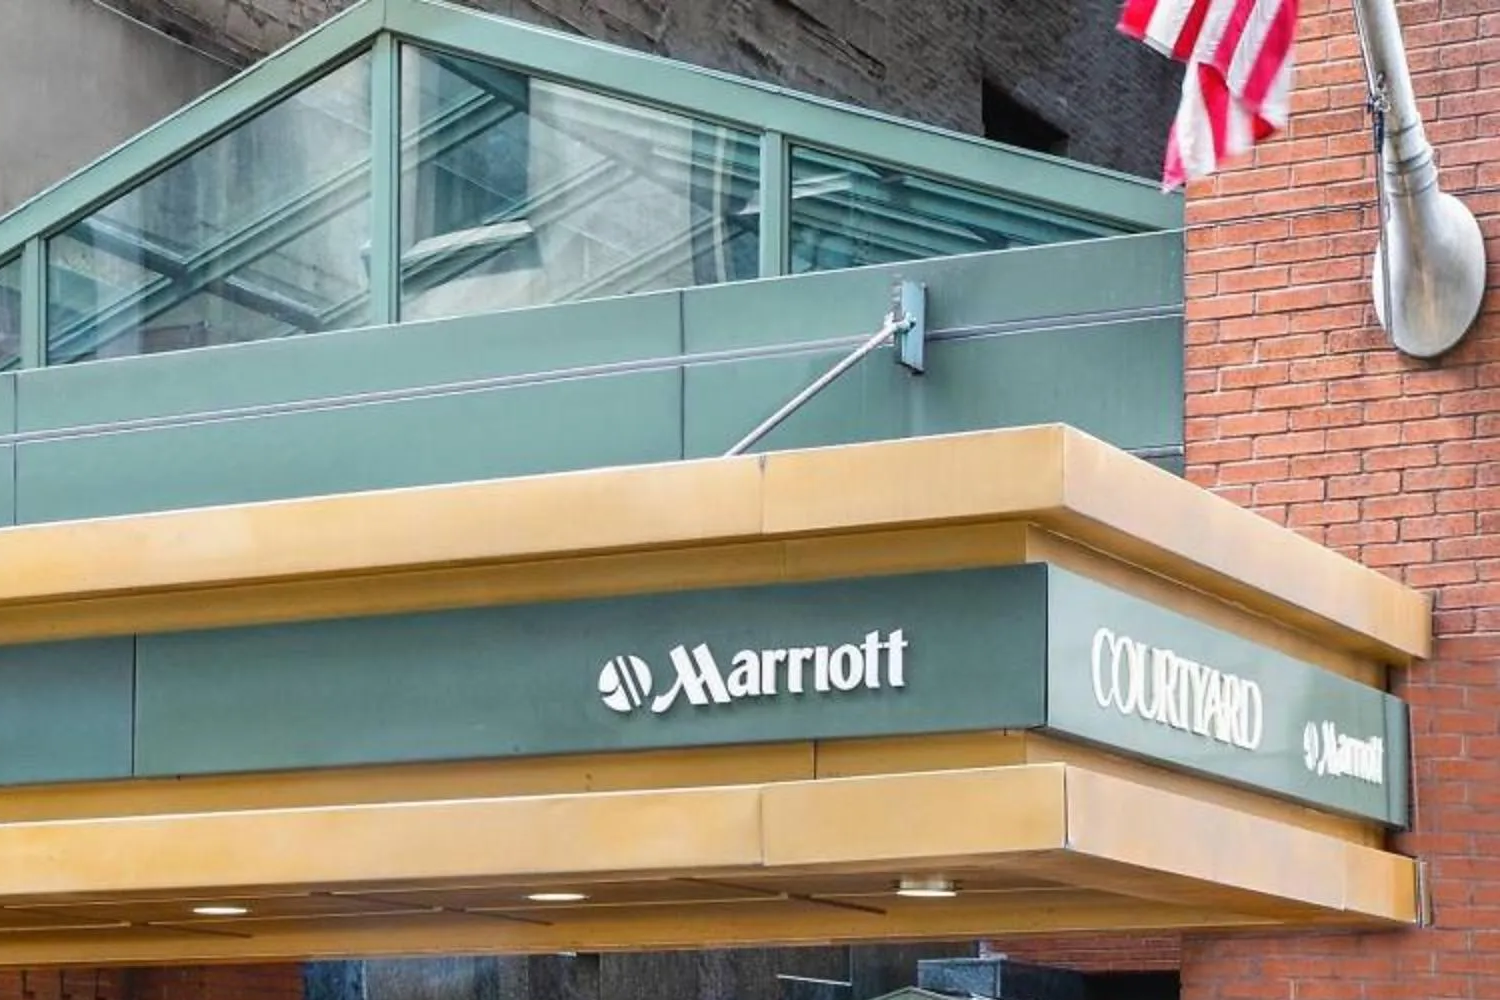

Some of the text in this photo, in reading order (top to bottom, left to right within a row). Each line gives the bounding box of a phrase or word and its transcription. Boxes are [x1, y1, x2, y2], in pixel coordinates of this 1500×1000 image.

[652, 630, 908, 713] Marriott
[1091, 627, 1263, 750] COURTYARD
[1318, 720, 1384, 784] Marriott
